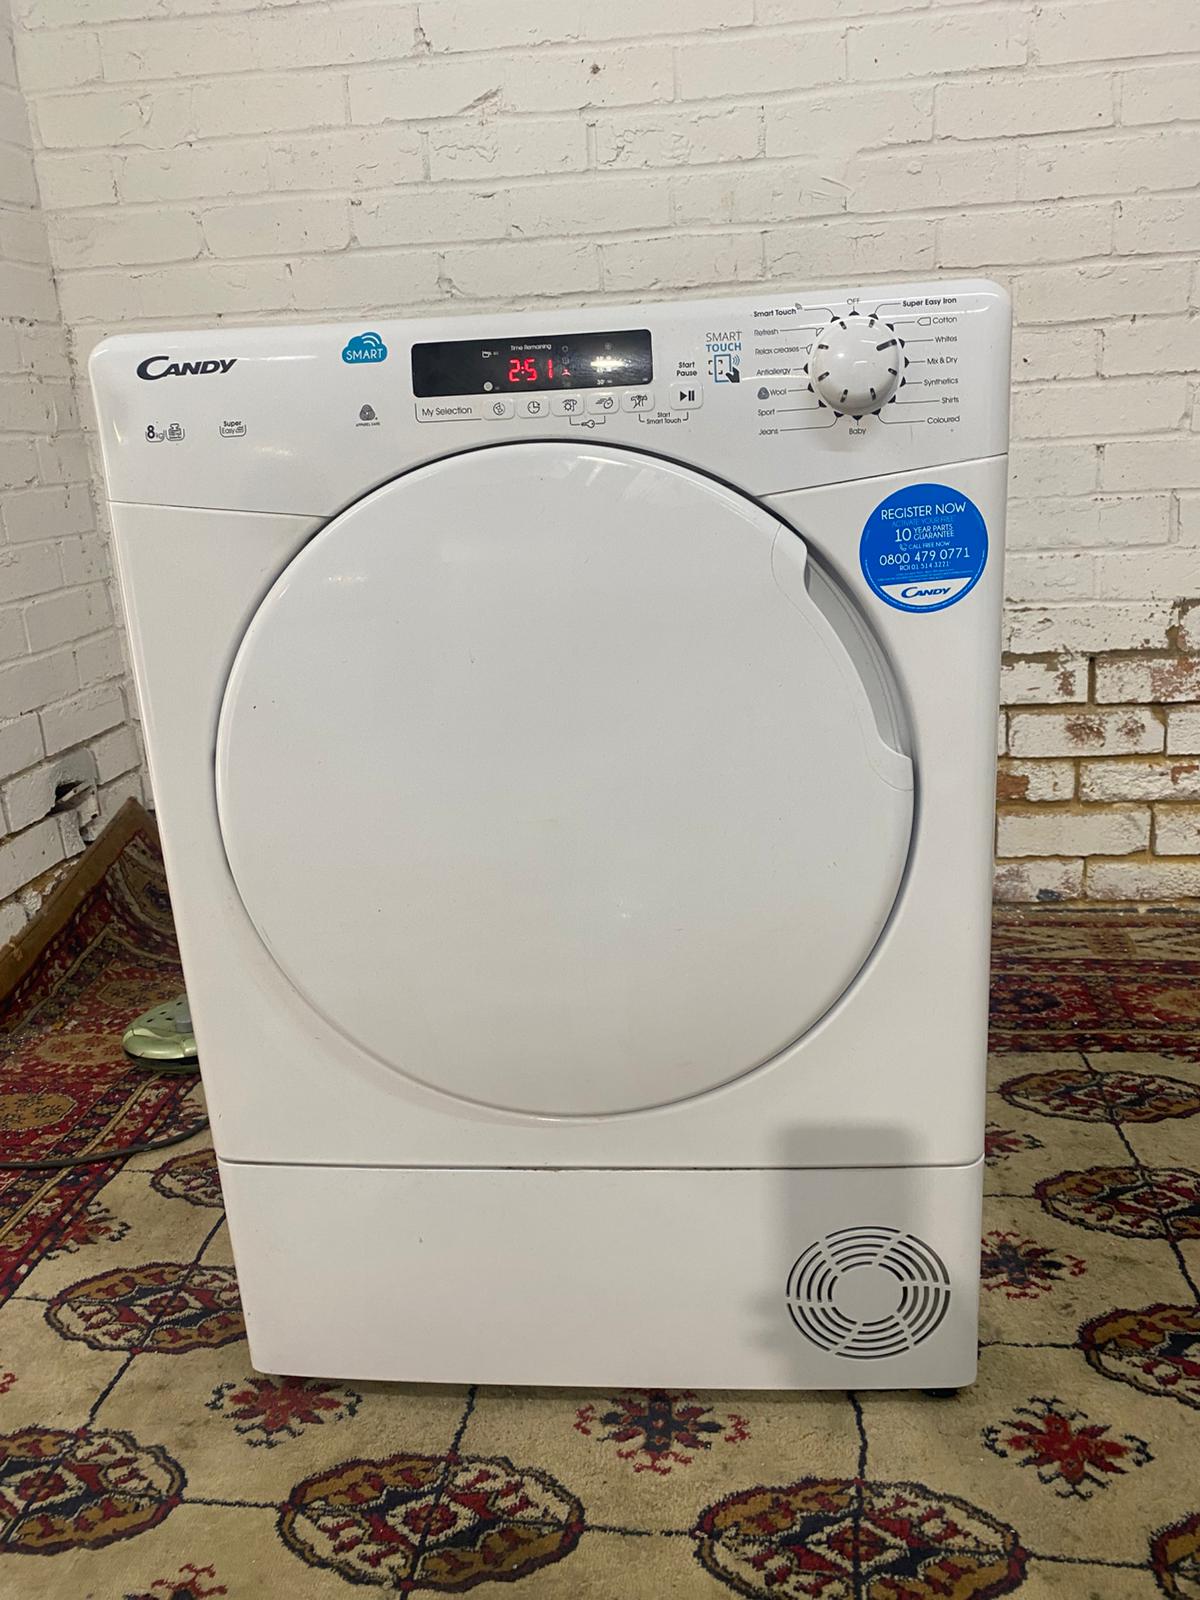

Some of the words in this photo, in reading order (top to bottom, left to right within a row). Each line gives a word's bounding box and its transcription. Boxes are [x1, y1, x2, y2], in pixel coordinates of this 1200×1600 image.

[847, 297, 860, 305] OFF
[902, 300, 923, 308] Super
[924, 299, 941, 307] Easy
[753, 309, 774, 318] Smart
[775, 307, 797, 317] Touch
[932, 315, 958, 325] Cotton
[705, 331, 742, 342] SMART
[753, 328, 779, 336] Refresh
[934, 336, 958, 344] Whites
[524, 343, 552, 351] Remaining
[705, 342, 742, 352] TOUCH
[755, 347, 773, 355] Relax
[773, 345, 800, 354] creases
[346, 348, 384, 361] SMART
[678, 361, 695, 369] Start
[927, 357, 939, 365] Mix
[945, 356, 958, 364] Dry
[508, 357, 554, 382] 2:51
[676, 369, 698, 377] Pause
[756, 366, 791, 376] Antiallergy
[923, 377, 959, 387] Synthetics
[770, 387, 787, 396] Wool
[941, 396, 960, 404] Shirts
[422, 407, 433, 417] My
[435, 406, 472, 416] Selection
[757, 408, 776, 417] Sport
[927, 415, 961, 425] Coloured
[758, 427, 778, 436] Jeans
[849, 427, 867, 436] Baby
[881, 504, 932, 520] REGISTER
[935, 502, 967, 515] NOW
[913, 526, 931, 534] YEAR
[932, 523, 953, 532] PARTS
[895, 528, 912, 543] 10
[913, 530, 955, 541] GUARANTEE
[879, 553, 911, 566] 0800
[914, 549, 936, 562] 479
[939, 547, 971, 561] 0771
